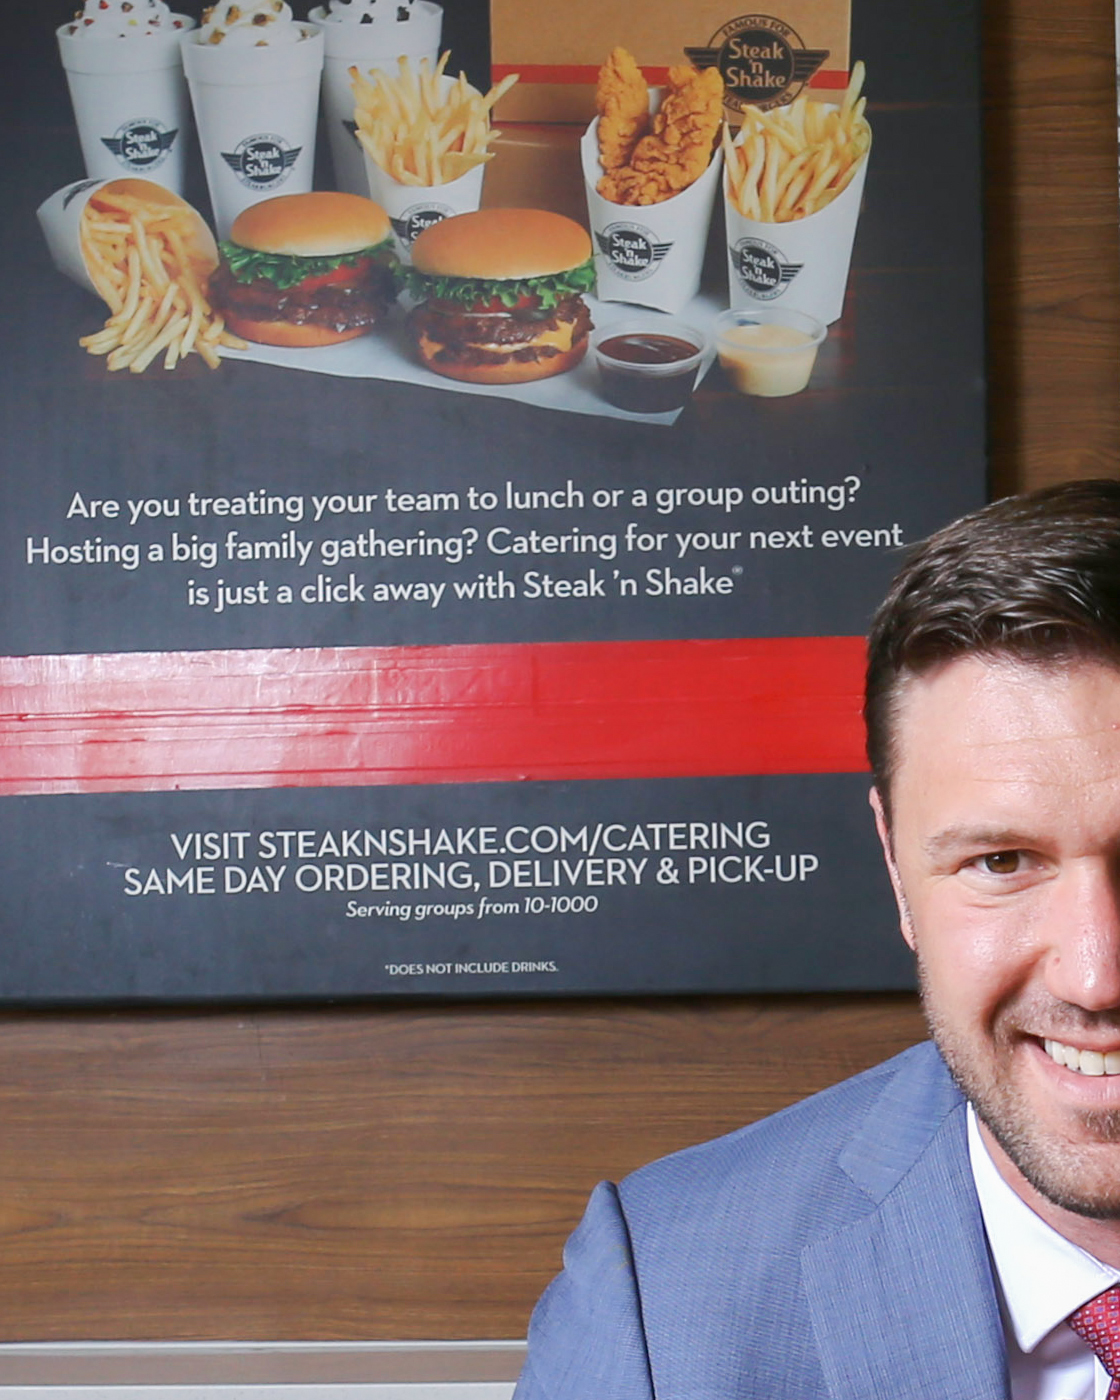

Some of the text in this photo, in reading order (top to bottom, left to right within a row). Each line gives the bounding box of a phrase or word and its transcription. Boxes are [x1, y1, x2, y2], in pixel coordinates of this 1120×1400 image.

[728, 38, 784, 59] Steak
[726, 67, 786, 88] Shake
[246, 147, 280, 161] Steak
[612, 233, 648, 250] Steak
[612, 250, 649, 267] Shake
[742, 249, 775, 269] Steak
[742, 265, 777, 286] Shake
[67, 476, 860, 525] Are you treating your team to lunch or a group outing?
[27, 523, 903, 570] Hosting a big family gathering? Catering for your next event
[188, 580, 209, 605] is
[214, 579, 269, 612] just
[277, 586, 294, 604] a
[301, 575, 366, 603] click
[373, 583, 446, 608] away
[453, 573, 515, 599] with
[523, 571, 605, 598] Steak
[613, 571, 637, 596] 'n
[170, 822, 770, 860] VISIT STEAKNSHAKE.COM/CATERING
[124, 855, 818, 895] SAME DAY ORDERING, DELIVERY & PICK-UP
[346, 896, 598, 921] Serving groups from 10-1000
[426, 963, 452, 974] NOT
[455, 962, 509, 973] INCLUDE
[512, 961, 558, 972] DRINKS.
